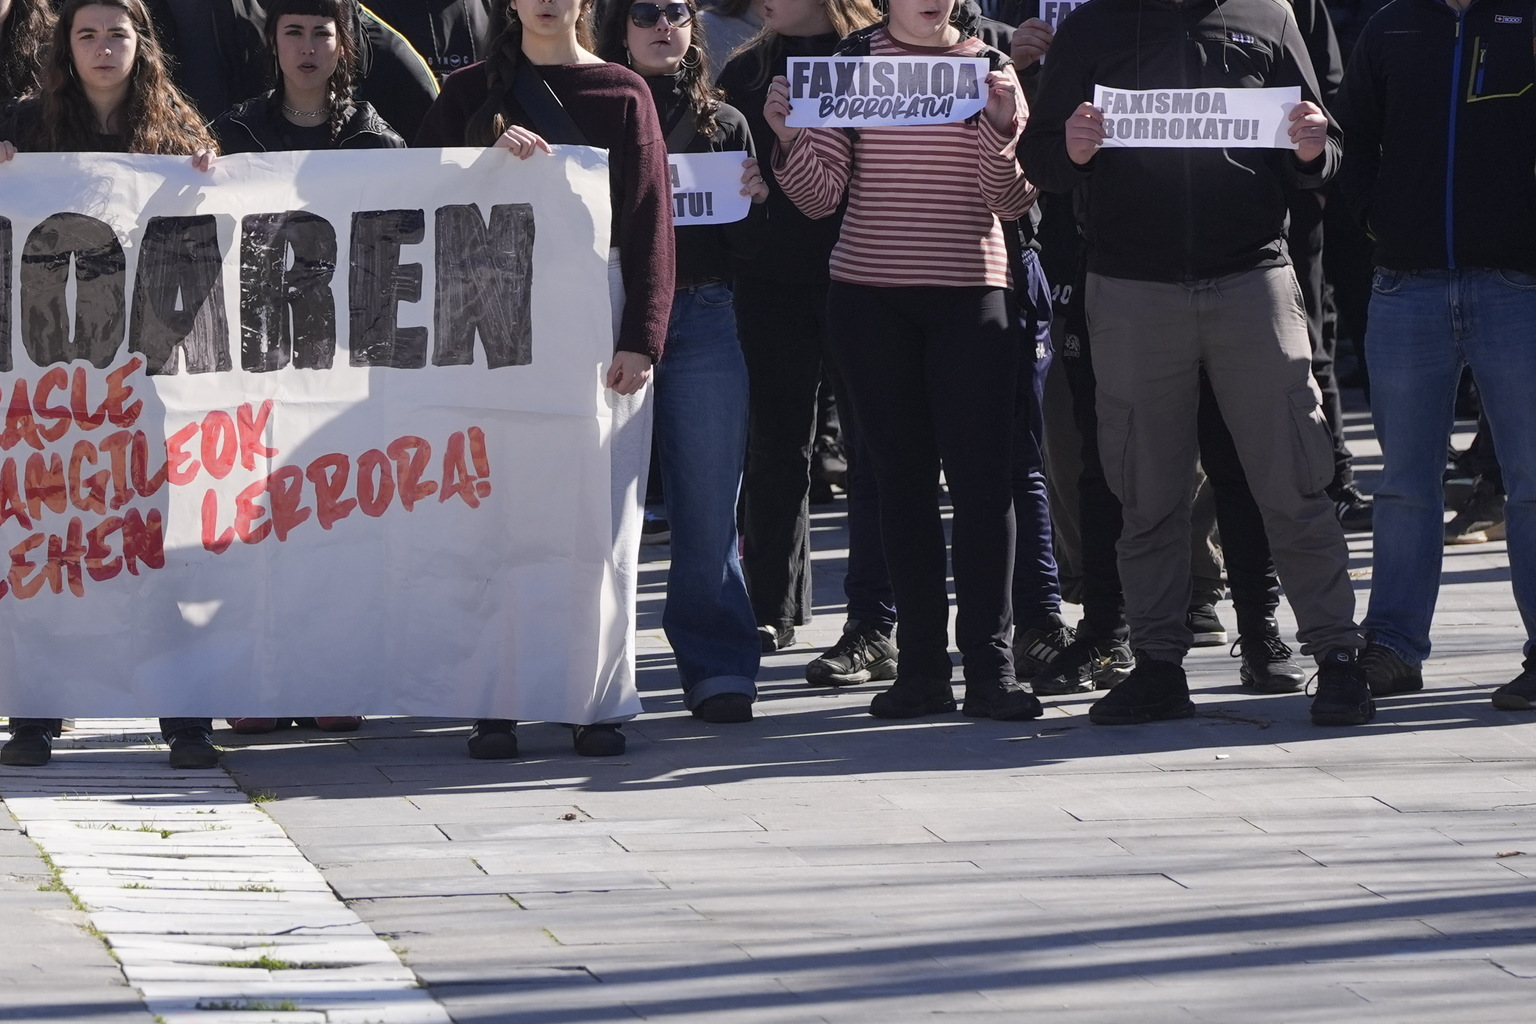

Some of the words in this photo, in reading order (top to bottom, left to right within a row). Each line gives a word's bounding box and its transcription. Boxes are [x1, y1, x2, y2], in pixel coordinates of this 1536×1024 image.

[792, 61, 980, 100] FAXISMOA
[818, 95, 954, 120] BORROKATU!
[1101, 90, 1228, 115] FAXISMOA
[1104, 117, 1260, 140] BORROKATU!
[201, 426, 492, 554] LERRORA!
